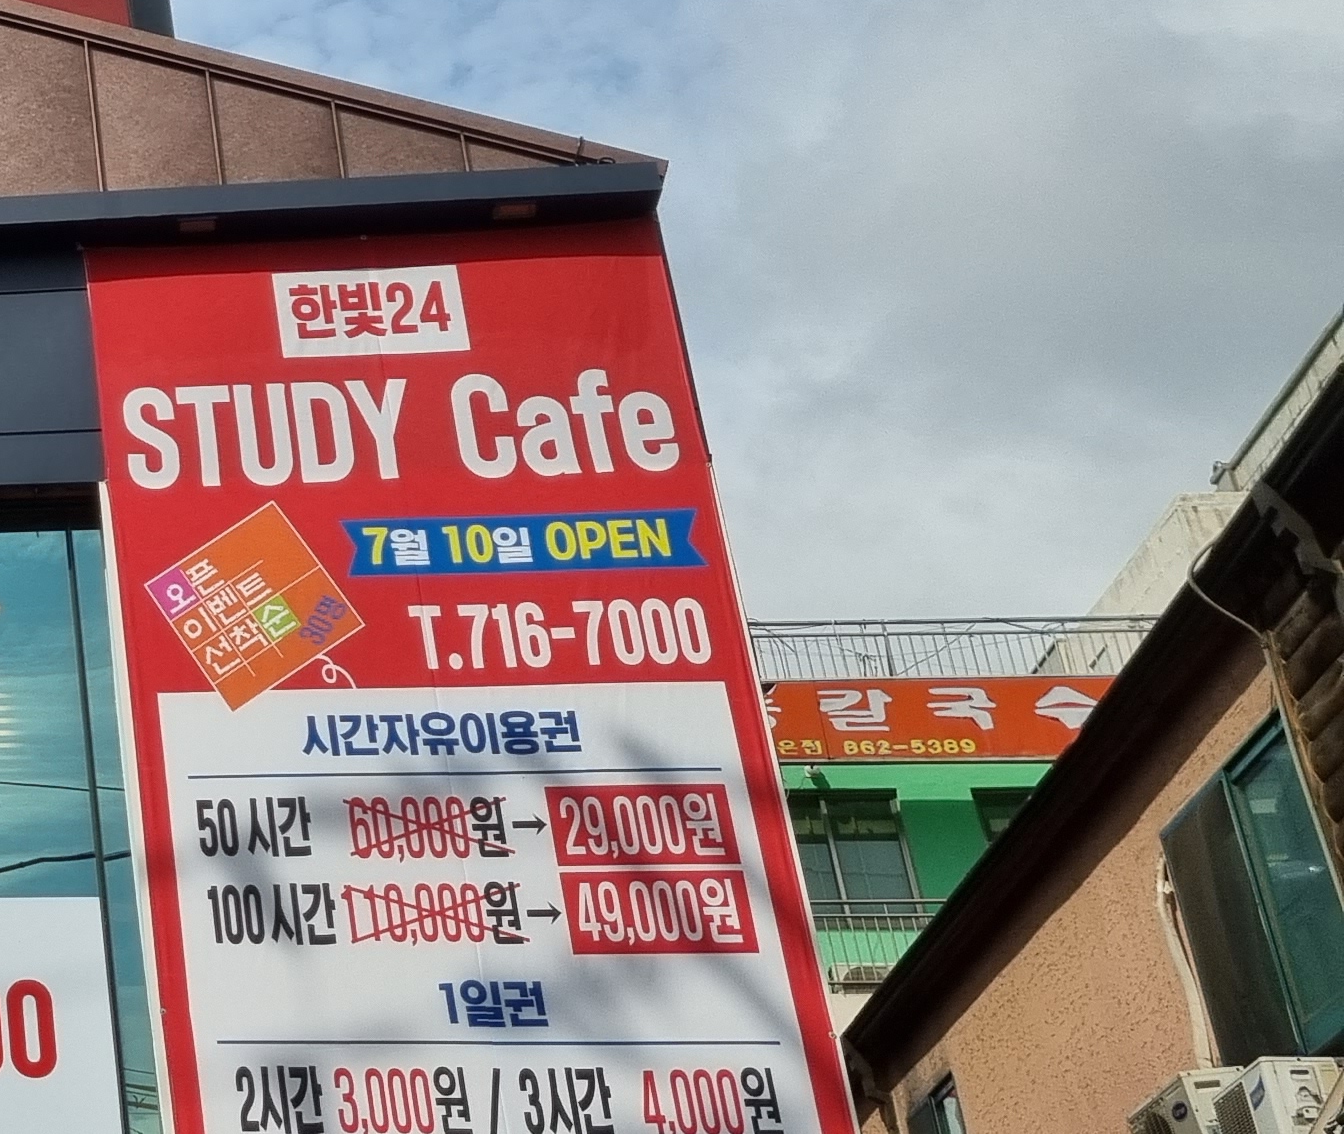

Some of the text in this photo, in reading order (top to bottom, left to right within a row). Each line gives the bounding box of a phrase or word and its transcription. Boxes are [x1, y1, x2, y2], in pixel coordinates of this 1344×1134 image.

[288, 280, 452, 340] 한빛24
[122, 369, 680, 490] STUDY Cafe
[361, 518, 672, 567] 7월 10일 OPEN
[408, 597, 713, 670] T.716-7000
[302, 711, 582, 758] 시간자유이용권
[765, 685, 1100, 733] 칼국수
[843, 738, 977, 756] 862-5389
[556, 793, 726, 858] 29,000원
[576, 880, 745, 946] 49,000원
[438, 980, 549, 1028] 1일권
[235, 1065, 323, 1133] 2시간
[518, 1067, 613, 1133] 3시간
